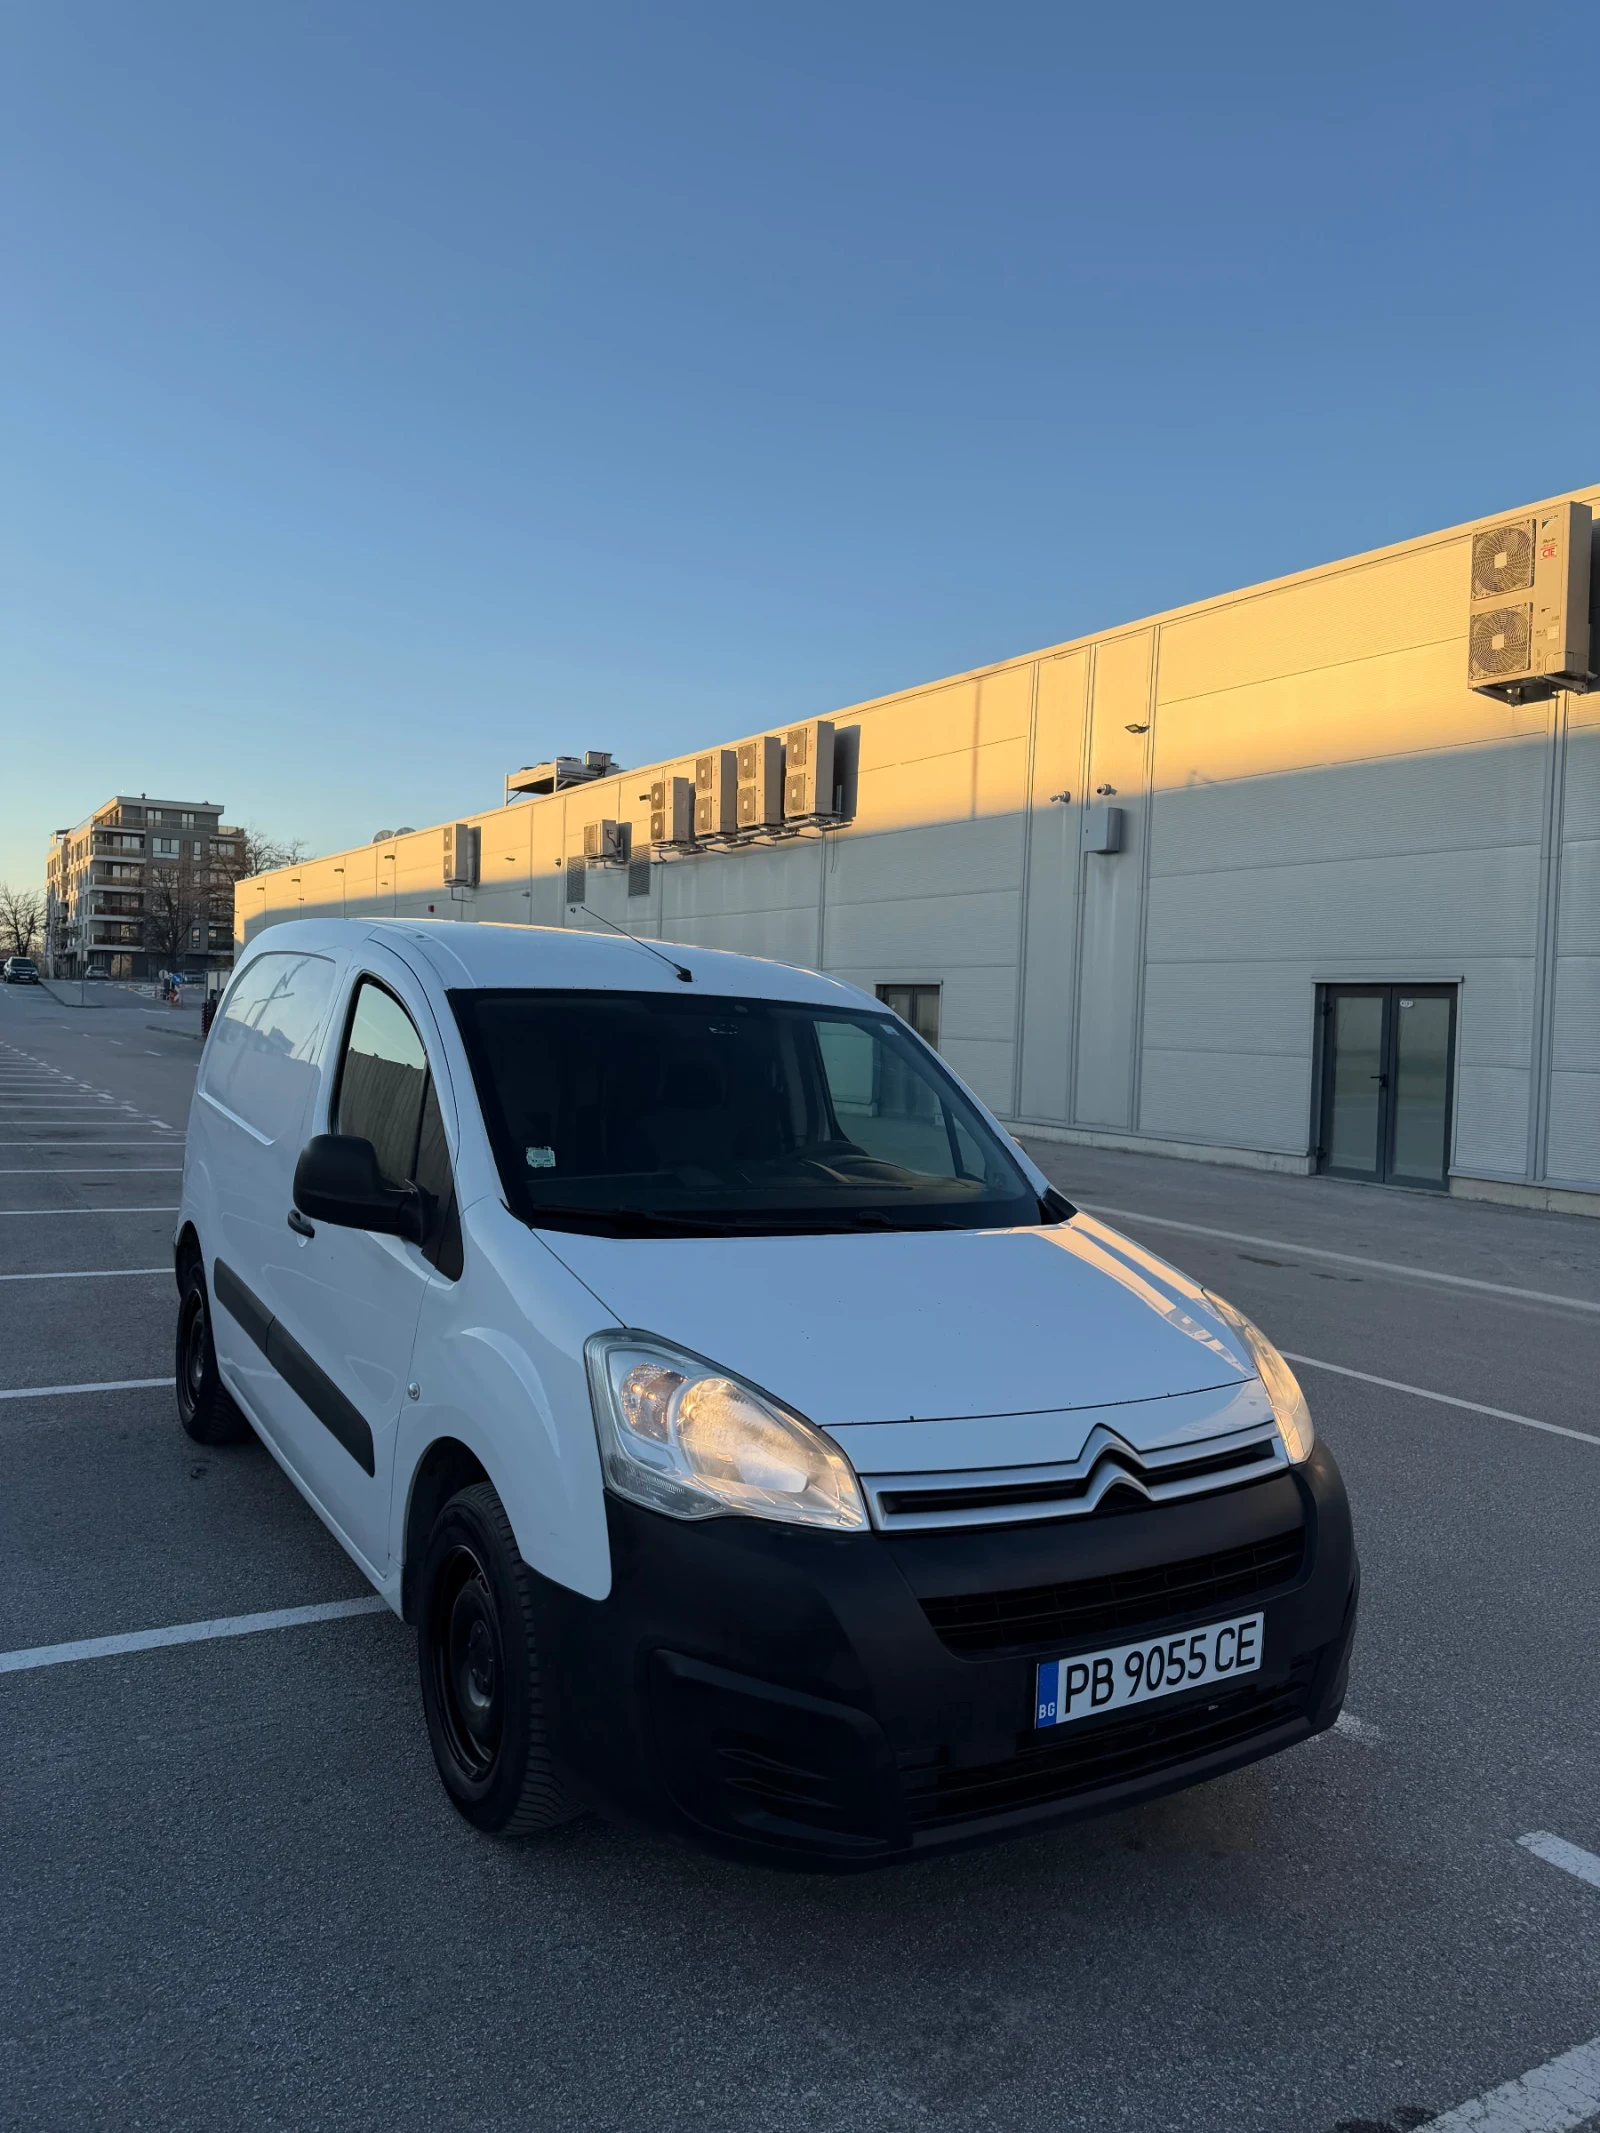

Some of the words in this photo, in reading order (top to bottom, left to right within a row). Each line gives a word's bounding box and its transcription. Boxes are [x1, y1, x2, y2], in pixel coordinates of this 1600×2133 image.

[1064, 1657, 1114, 1714] PB
[1124, 1633, 1207, 1698] 9055
[1214, 1620, 1257, 1672] CE
[1038, 1702, 1056, 1720] BG
